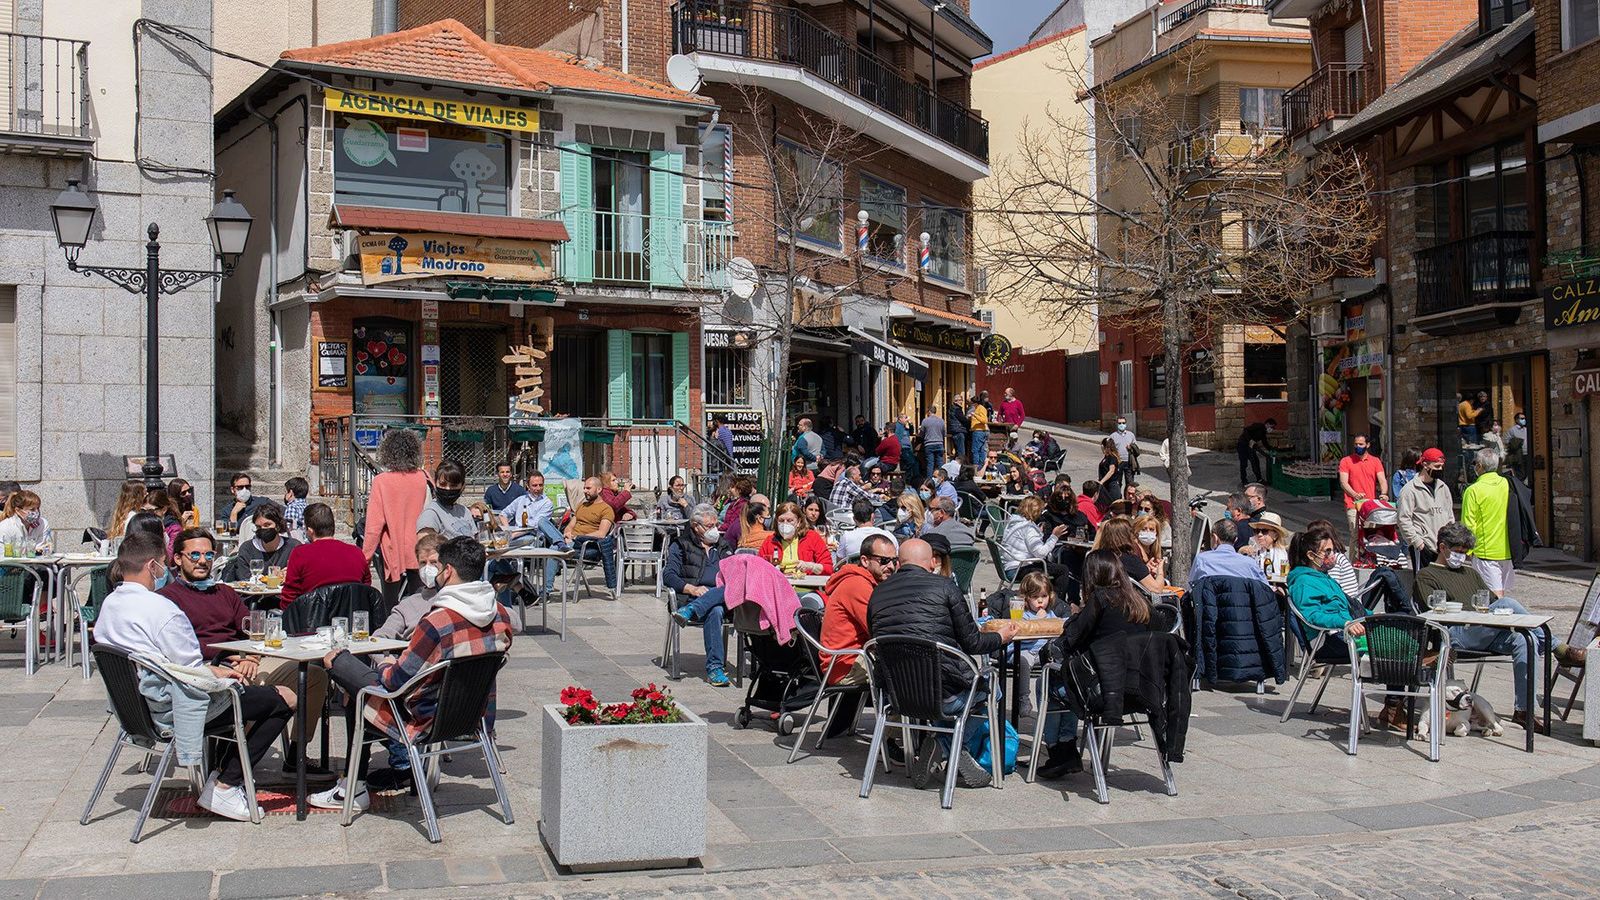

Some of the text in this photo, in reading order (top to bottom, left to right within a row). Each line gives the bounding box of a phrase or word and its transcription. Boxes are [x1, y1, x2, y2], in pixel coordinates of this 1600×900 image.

[339, 92, 529, 128] AGENCIA DE VIAJES
[423, 240, 465, 257] Viajes
[422, 256, 485, 272] Madroño
[1551, 279, 1600, 301] CALZ
[873, 345, 886, 362] BAR
[887, 351, 895, 367] EL
[895, 355, 910, 374] PASO
[727, 412, 759, 421] EL PASO
[732, 434, 760, 442] AYUNOS
